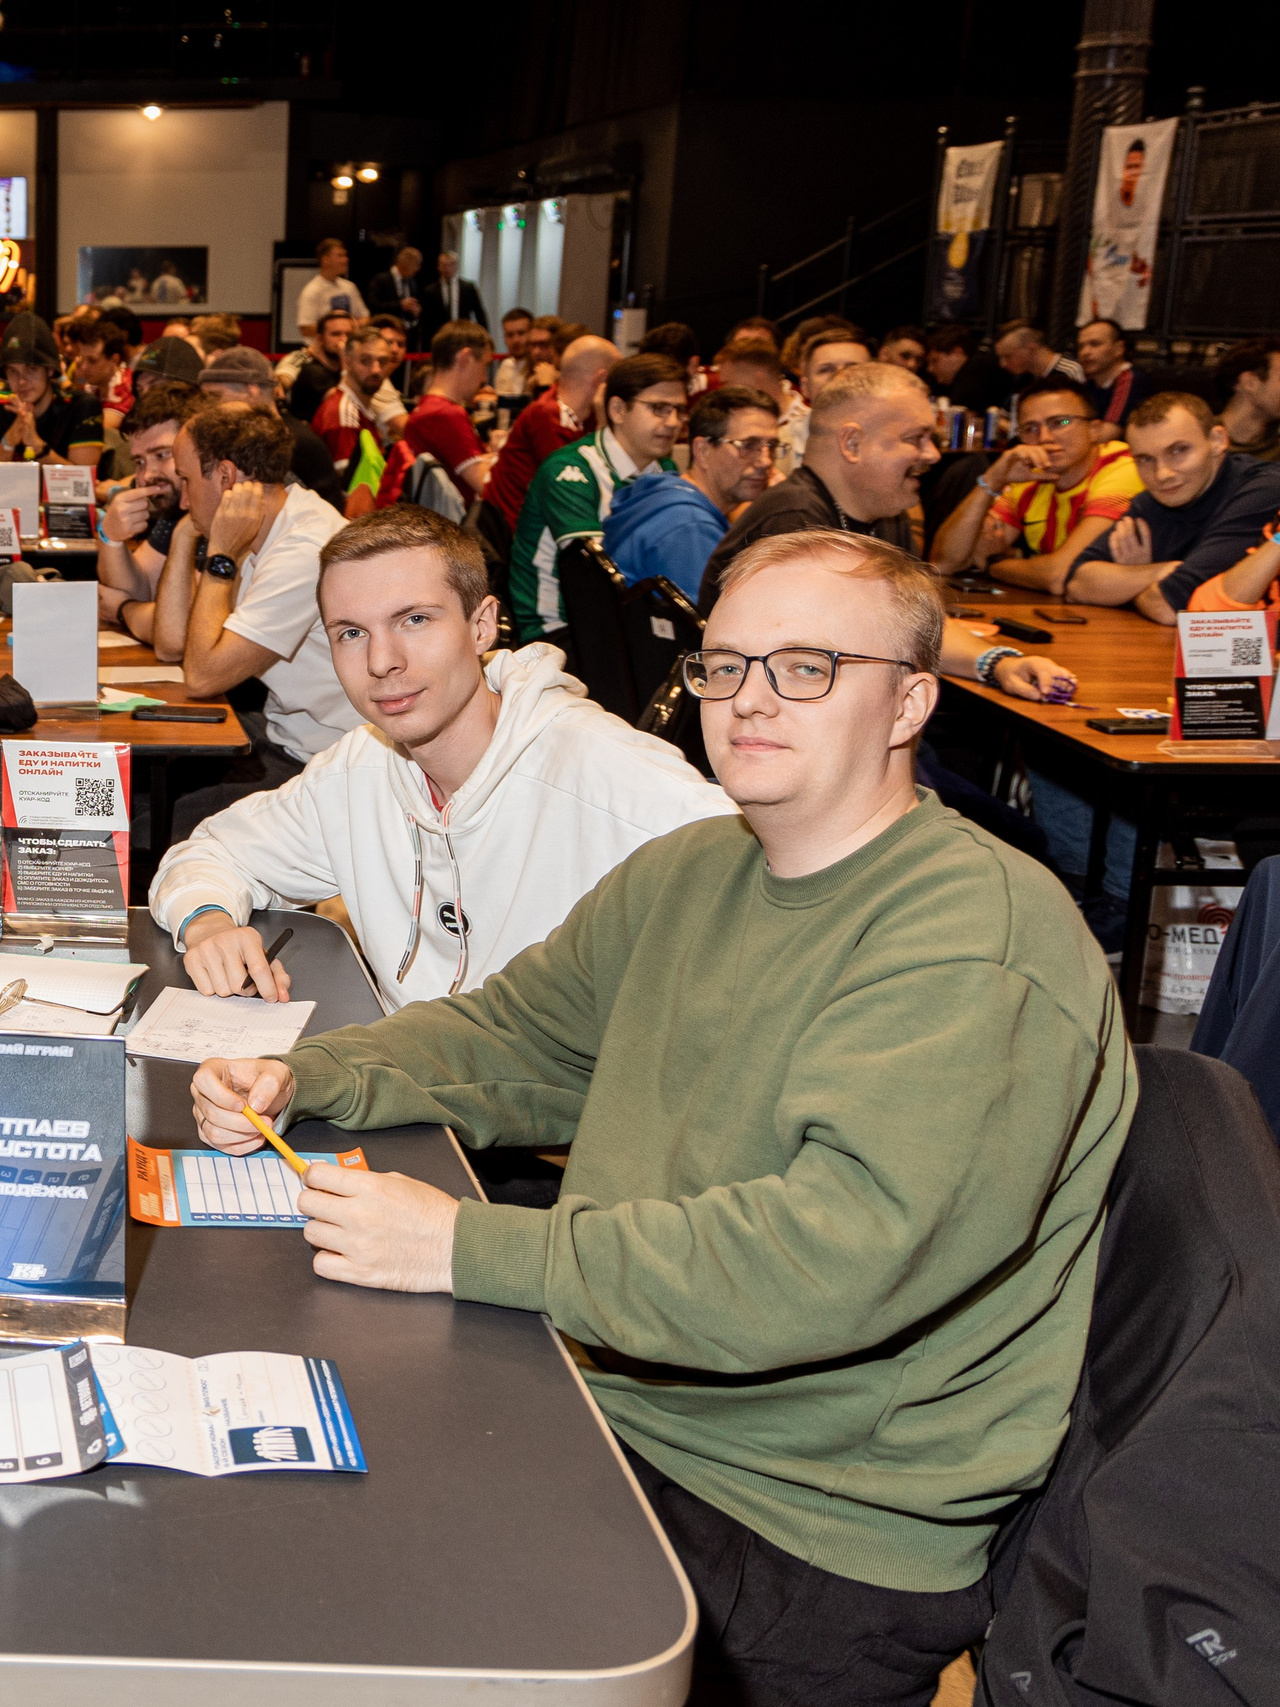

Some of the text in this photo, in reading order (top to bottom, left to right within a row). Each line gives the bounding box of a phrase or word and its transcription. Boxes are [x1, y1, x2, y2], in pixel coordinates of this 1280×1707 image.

[18, 749, 98, 759] ЗАКАЗЫВАЙТЕ
[18, 759, 40, 767] ЕДУ
[50, 760, 101, 768] НАПИТКИ
[18, 767, 63, 776] ОНЛАЙН
[17, 838, 107, 848] ЧТОБЫ СДЕЛАТЬ
[17, 846, 57, 855] ЗАКАЗ:
[135, 1154, 149, 1182] РАУНД
